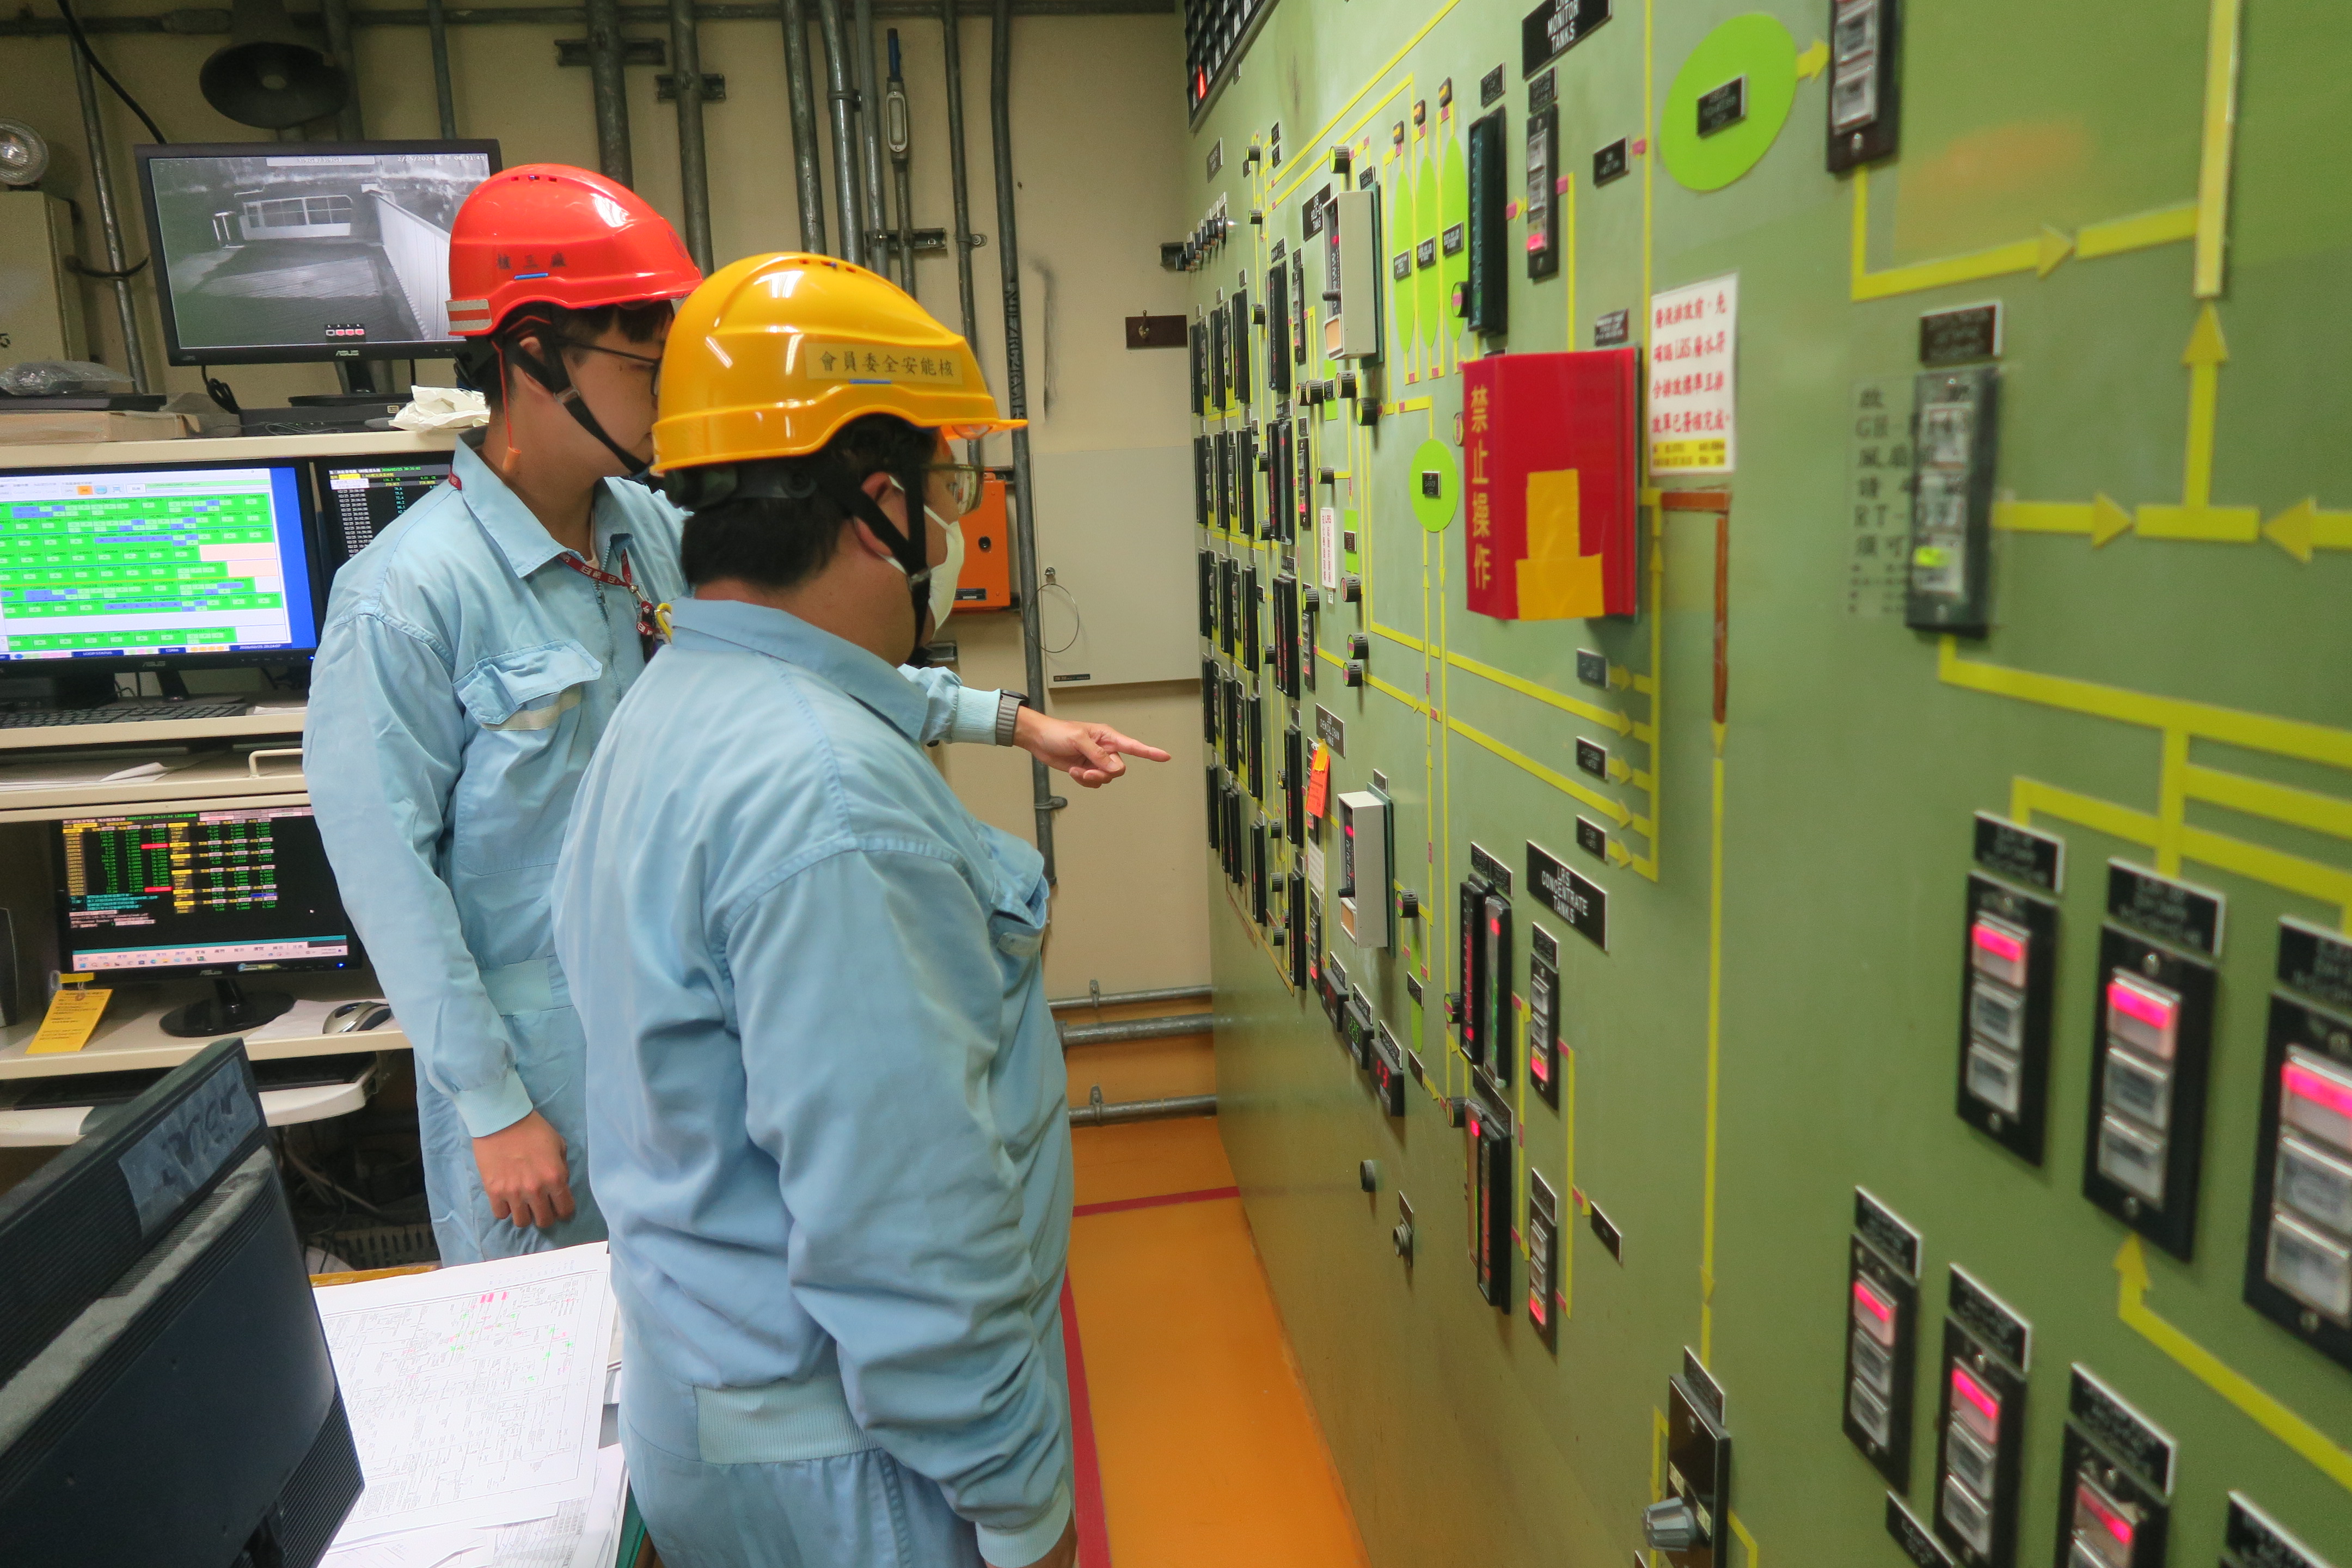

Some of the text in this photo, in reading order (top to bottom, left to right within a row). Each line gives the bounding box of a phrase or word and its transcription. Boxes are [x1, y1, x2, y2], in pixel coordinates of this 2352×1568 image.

[1547, 0, 1579, 38] MONITOR
[1551, 21, 1576, 55] TANKS
[1471, 384, 1491, 591] 禁止操作
[1541, 870, 1589, 917] CONCENTRATE
[1557, 865, 1571, 887] LRS
[1553, 895, 1575, 924] TANKS
